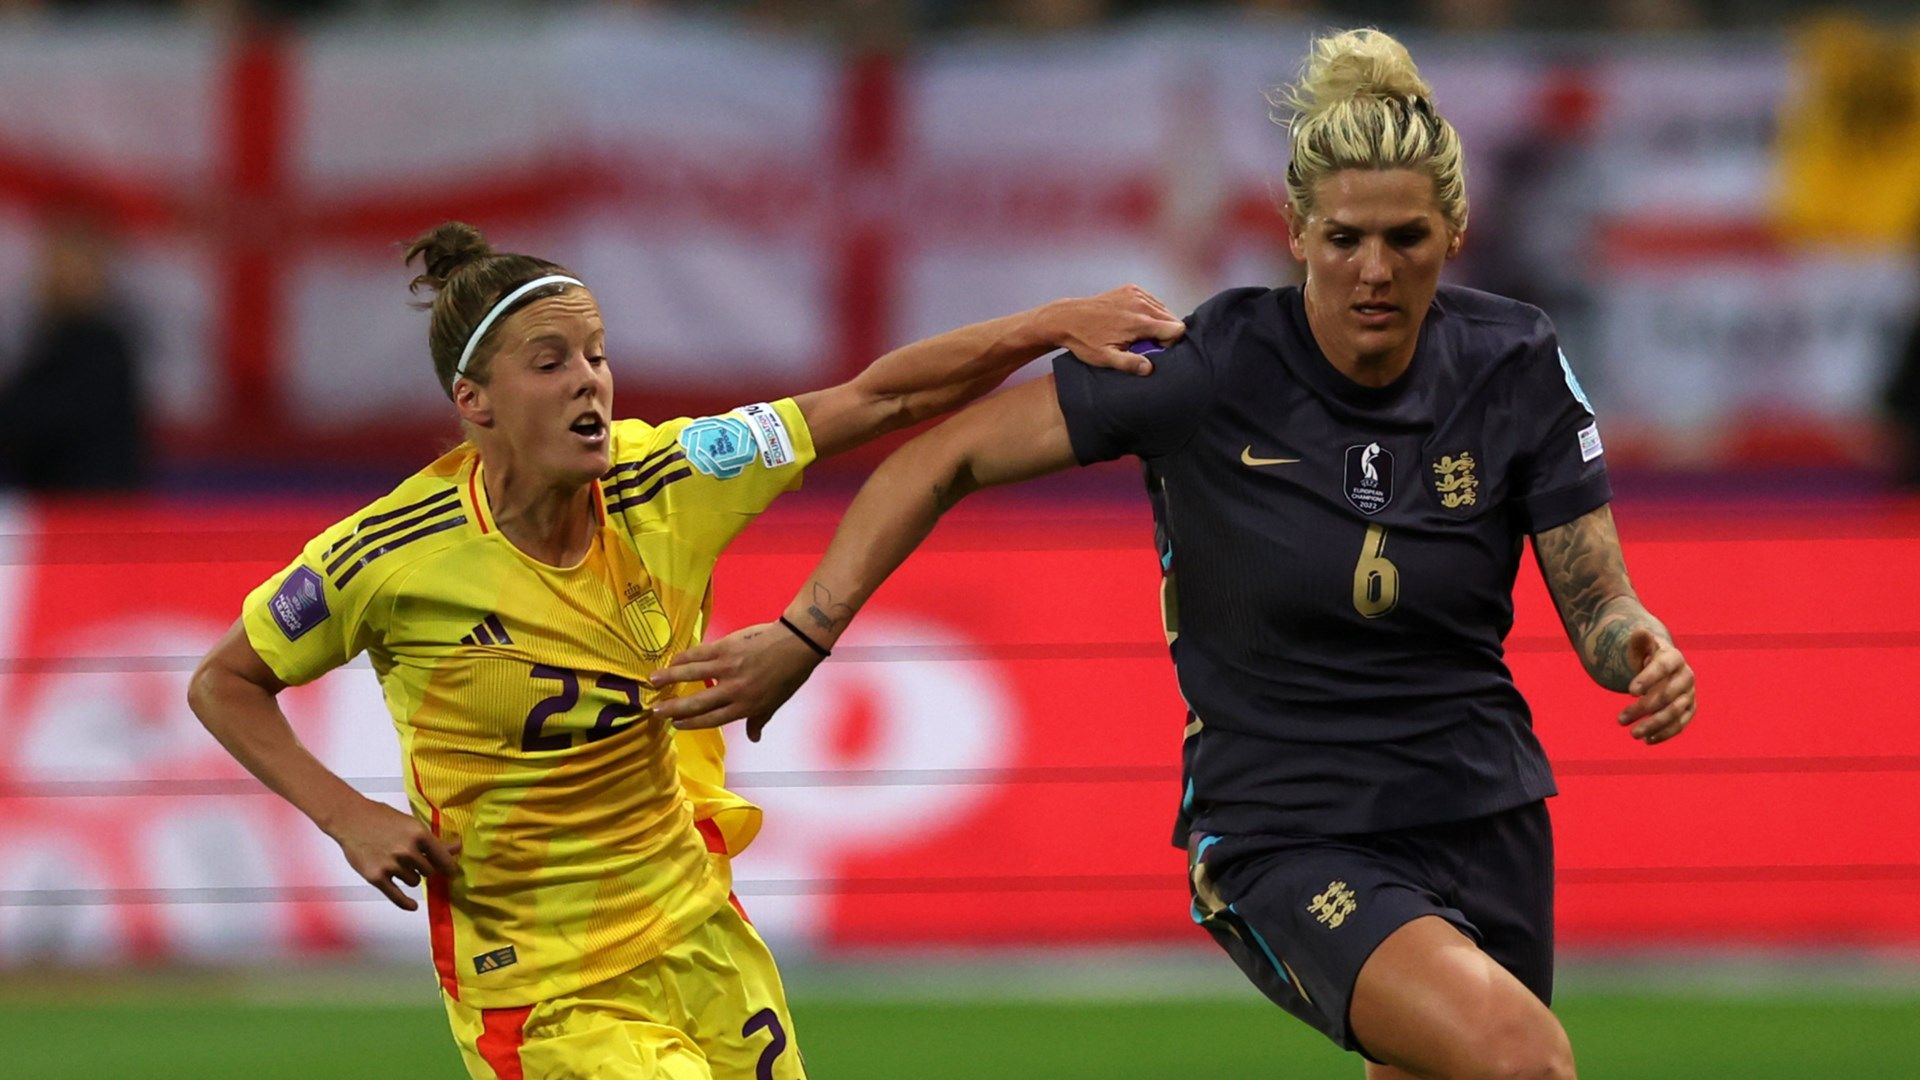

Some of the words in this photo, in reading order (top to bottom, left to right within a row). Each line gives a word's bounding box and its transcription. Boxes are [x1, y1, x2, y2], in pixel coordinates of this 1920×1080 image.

[759, 415, 782, 464] FOUNDATION
[1351, 493, 1385, 503] CHAMPIONS
[1353, 488, 1384, 496] EUROPEAN
[1352, 523, 1400, 619] 6
[275, 600, 296, 632] LEAGUE
[279, 594, 302, 629] NATIONS
[522, 664, 643, 752] 22
